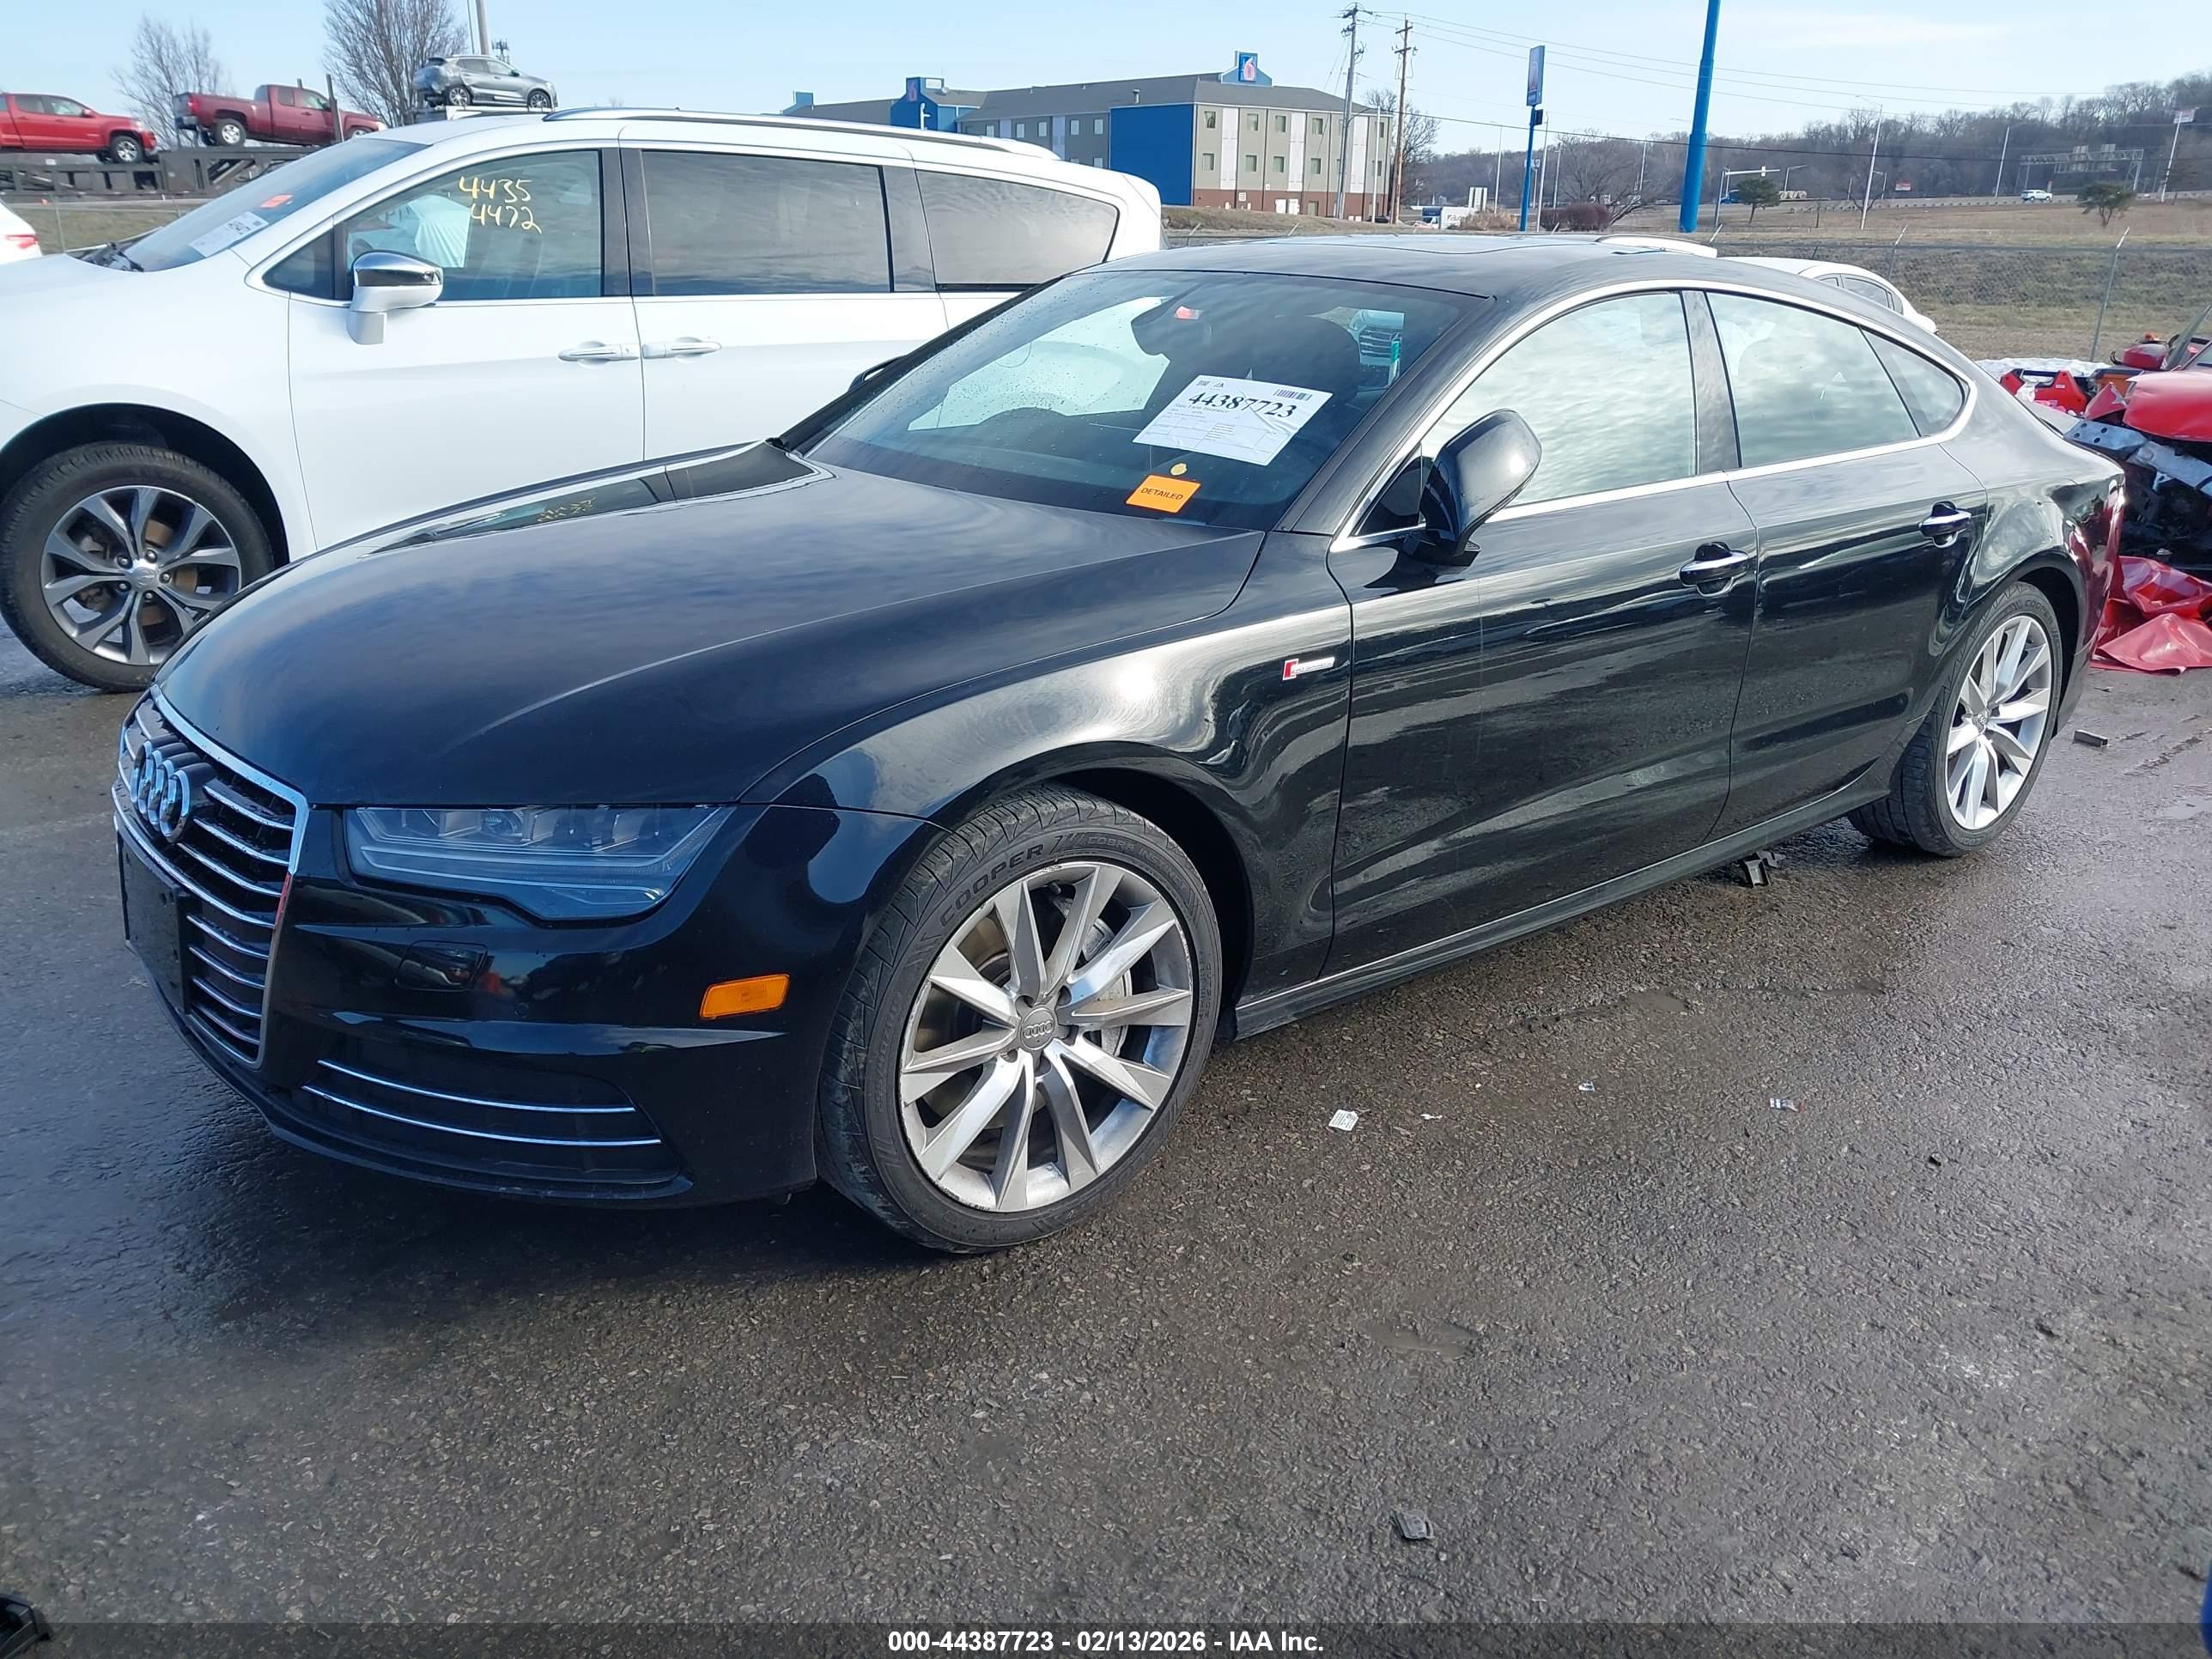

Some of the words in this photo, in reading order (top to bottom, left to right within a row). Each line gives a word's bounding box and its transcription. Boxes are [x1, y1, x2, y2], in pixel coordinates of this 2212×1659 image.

[1243, 57, 1255, 82] 6
[459, 176, 532, 203] 4435
[471, 203, 542, 234] 4472
[1188, 392, 1297, 418] 44387723
[1140, 487, 1183, 501] DETAILED
[939, 843, 1044, 927] COOPER
